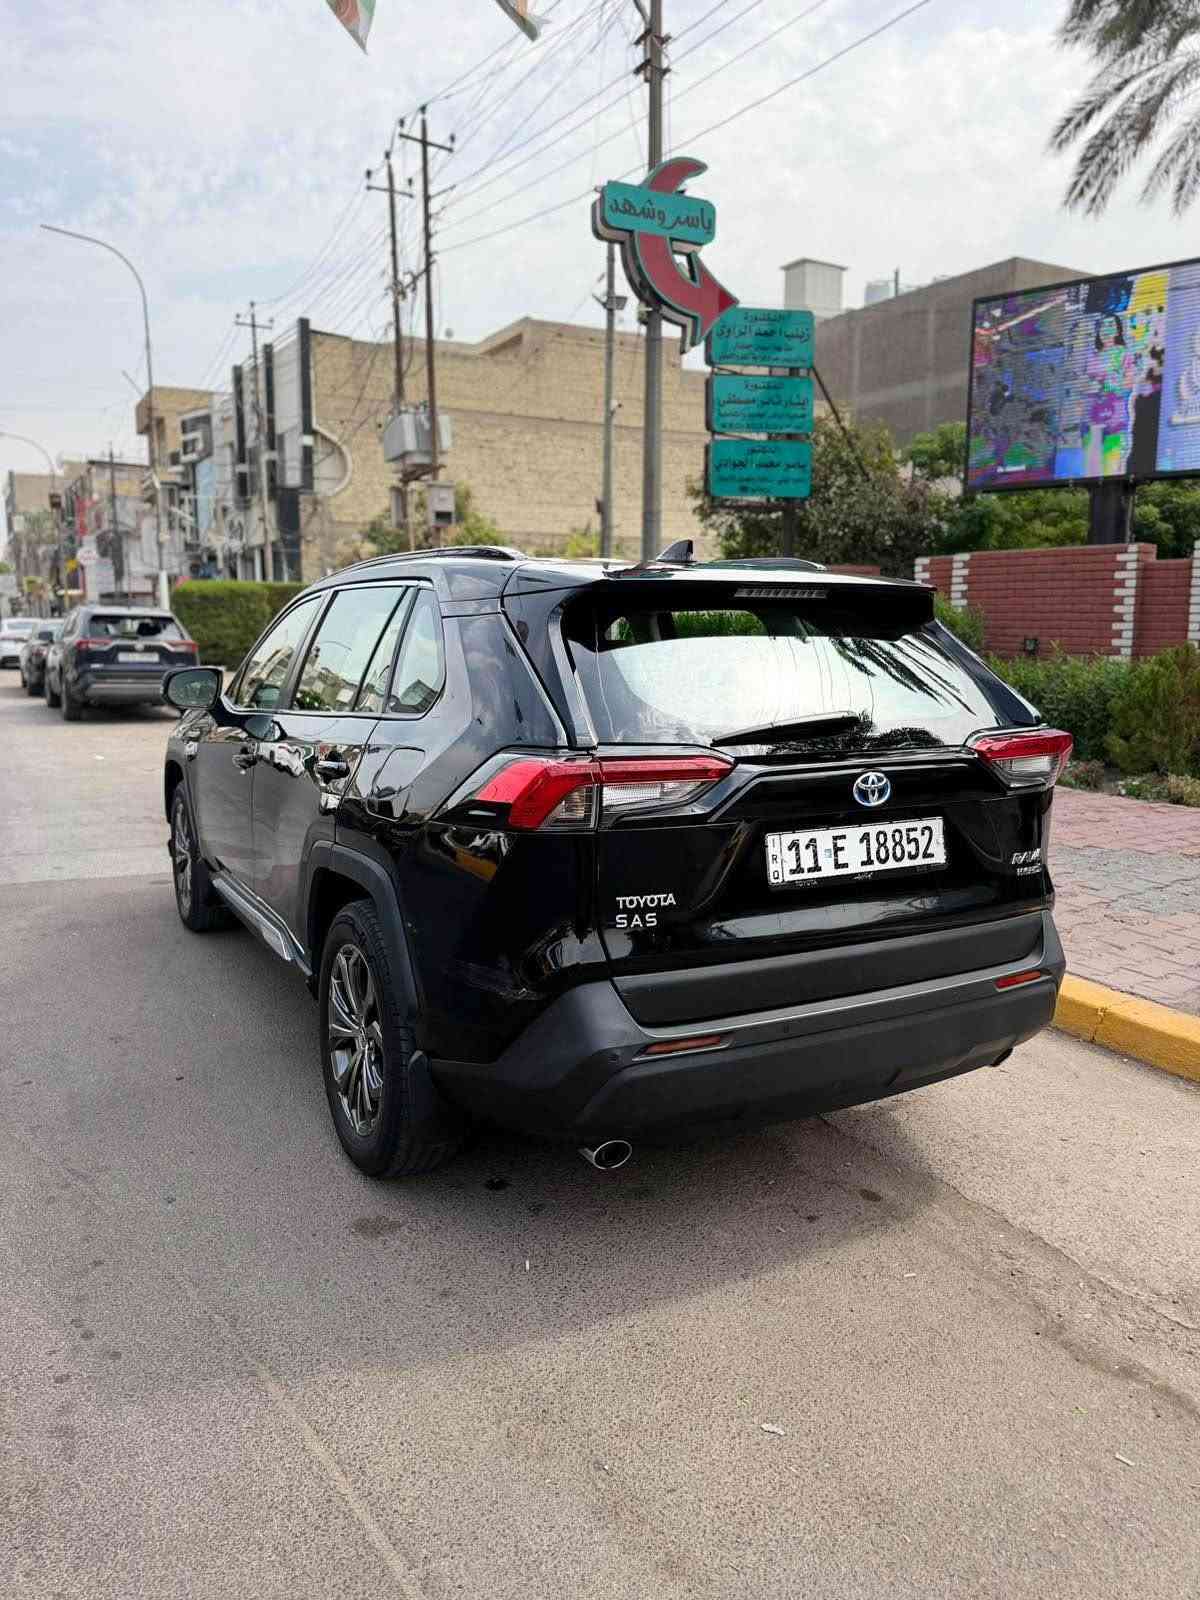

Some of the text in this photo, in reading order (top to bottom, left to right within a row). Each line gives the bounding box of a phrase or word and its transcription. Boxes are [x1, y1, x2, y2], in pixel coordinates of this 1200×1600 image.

[661, 207, 713, 235] ياسر
[788, 825, 935, 875] 11 E 18852
[615, 893, 677, 909] TOYOTA
[615, 912, 658, 928] SAS
